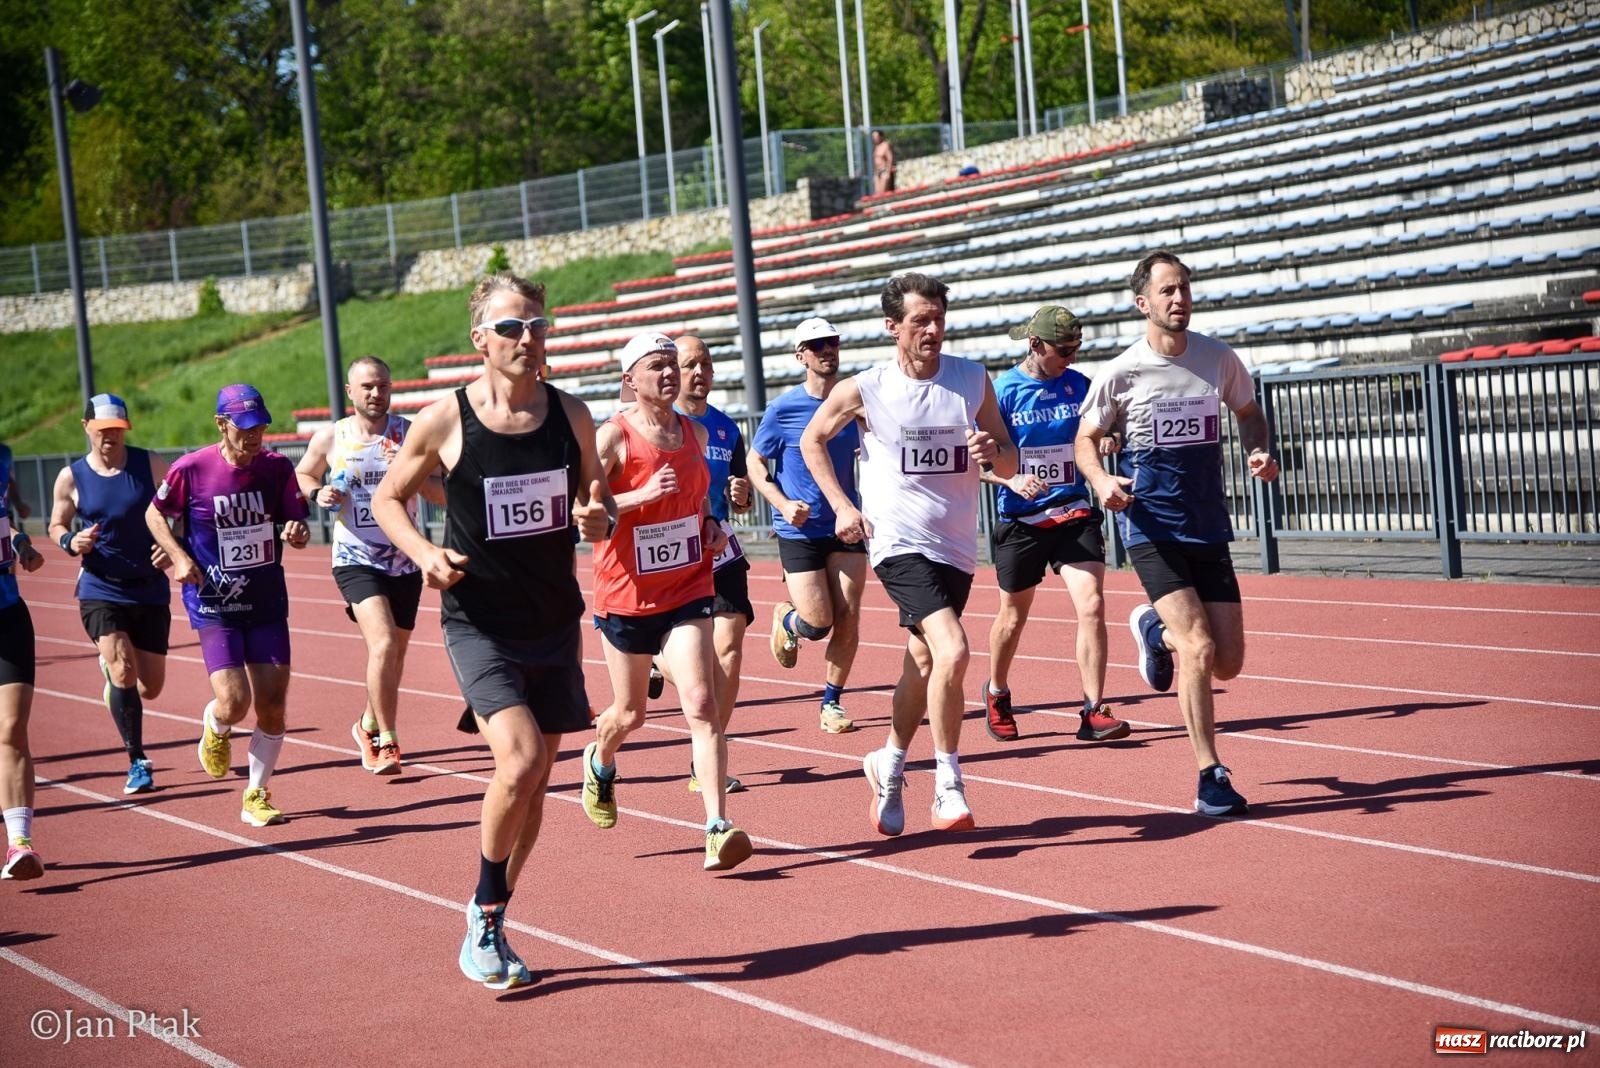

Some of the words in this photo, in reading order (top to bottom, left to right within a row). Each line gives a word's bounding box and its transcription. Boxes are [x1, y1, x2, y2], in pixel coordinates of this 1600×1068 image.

[1011, 402, 1082, 426] RUNNER
[1162, 418, 1200, 437] 225
[912, 448, 948, 466] 140
[1030, 464, 1059, 479] 166
[491, 481, 504, 489] XVIII
[506, 480, 519, 488] BIEG
[531, 476, 551, 485] GRANIC
[491, 487, 523, 496] 3MAJA2026
[213, 491, 265, 528] RUN
[501, 500, 544, 526] 156
[231, 544, 259, 561] 231
[648, 541, 681, 564] 167
